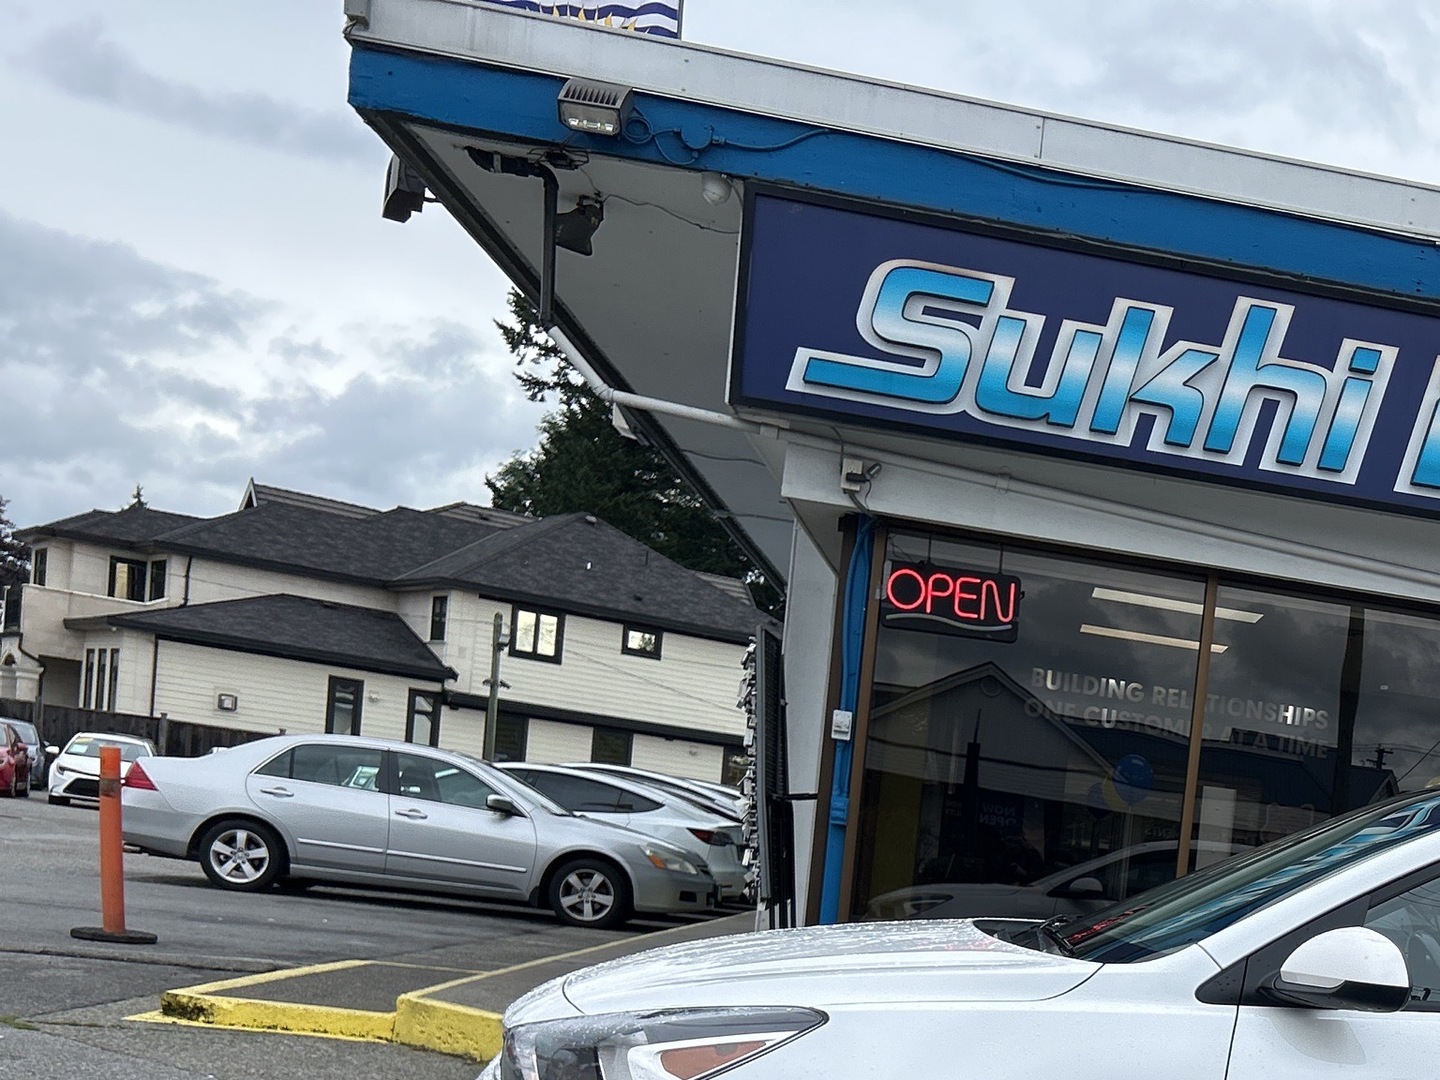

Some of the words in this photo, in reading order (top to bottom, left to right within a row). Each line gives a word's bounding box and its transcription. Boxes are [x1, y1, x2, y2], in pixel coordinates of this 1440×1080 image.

[788, 259, 1397, 484] Sukhi
[887, 569, 1015, 622] OPEN
[1024, 697, 1077, 725] ONE
[1083, 706, 1213, 741] CUSTOMR
[1277, 734, 1329, 759] TIME
[1031, 667, 1144, 703] BUILDING
[1151, 685, 1328, 730] RELTIONSHIPS
